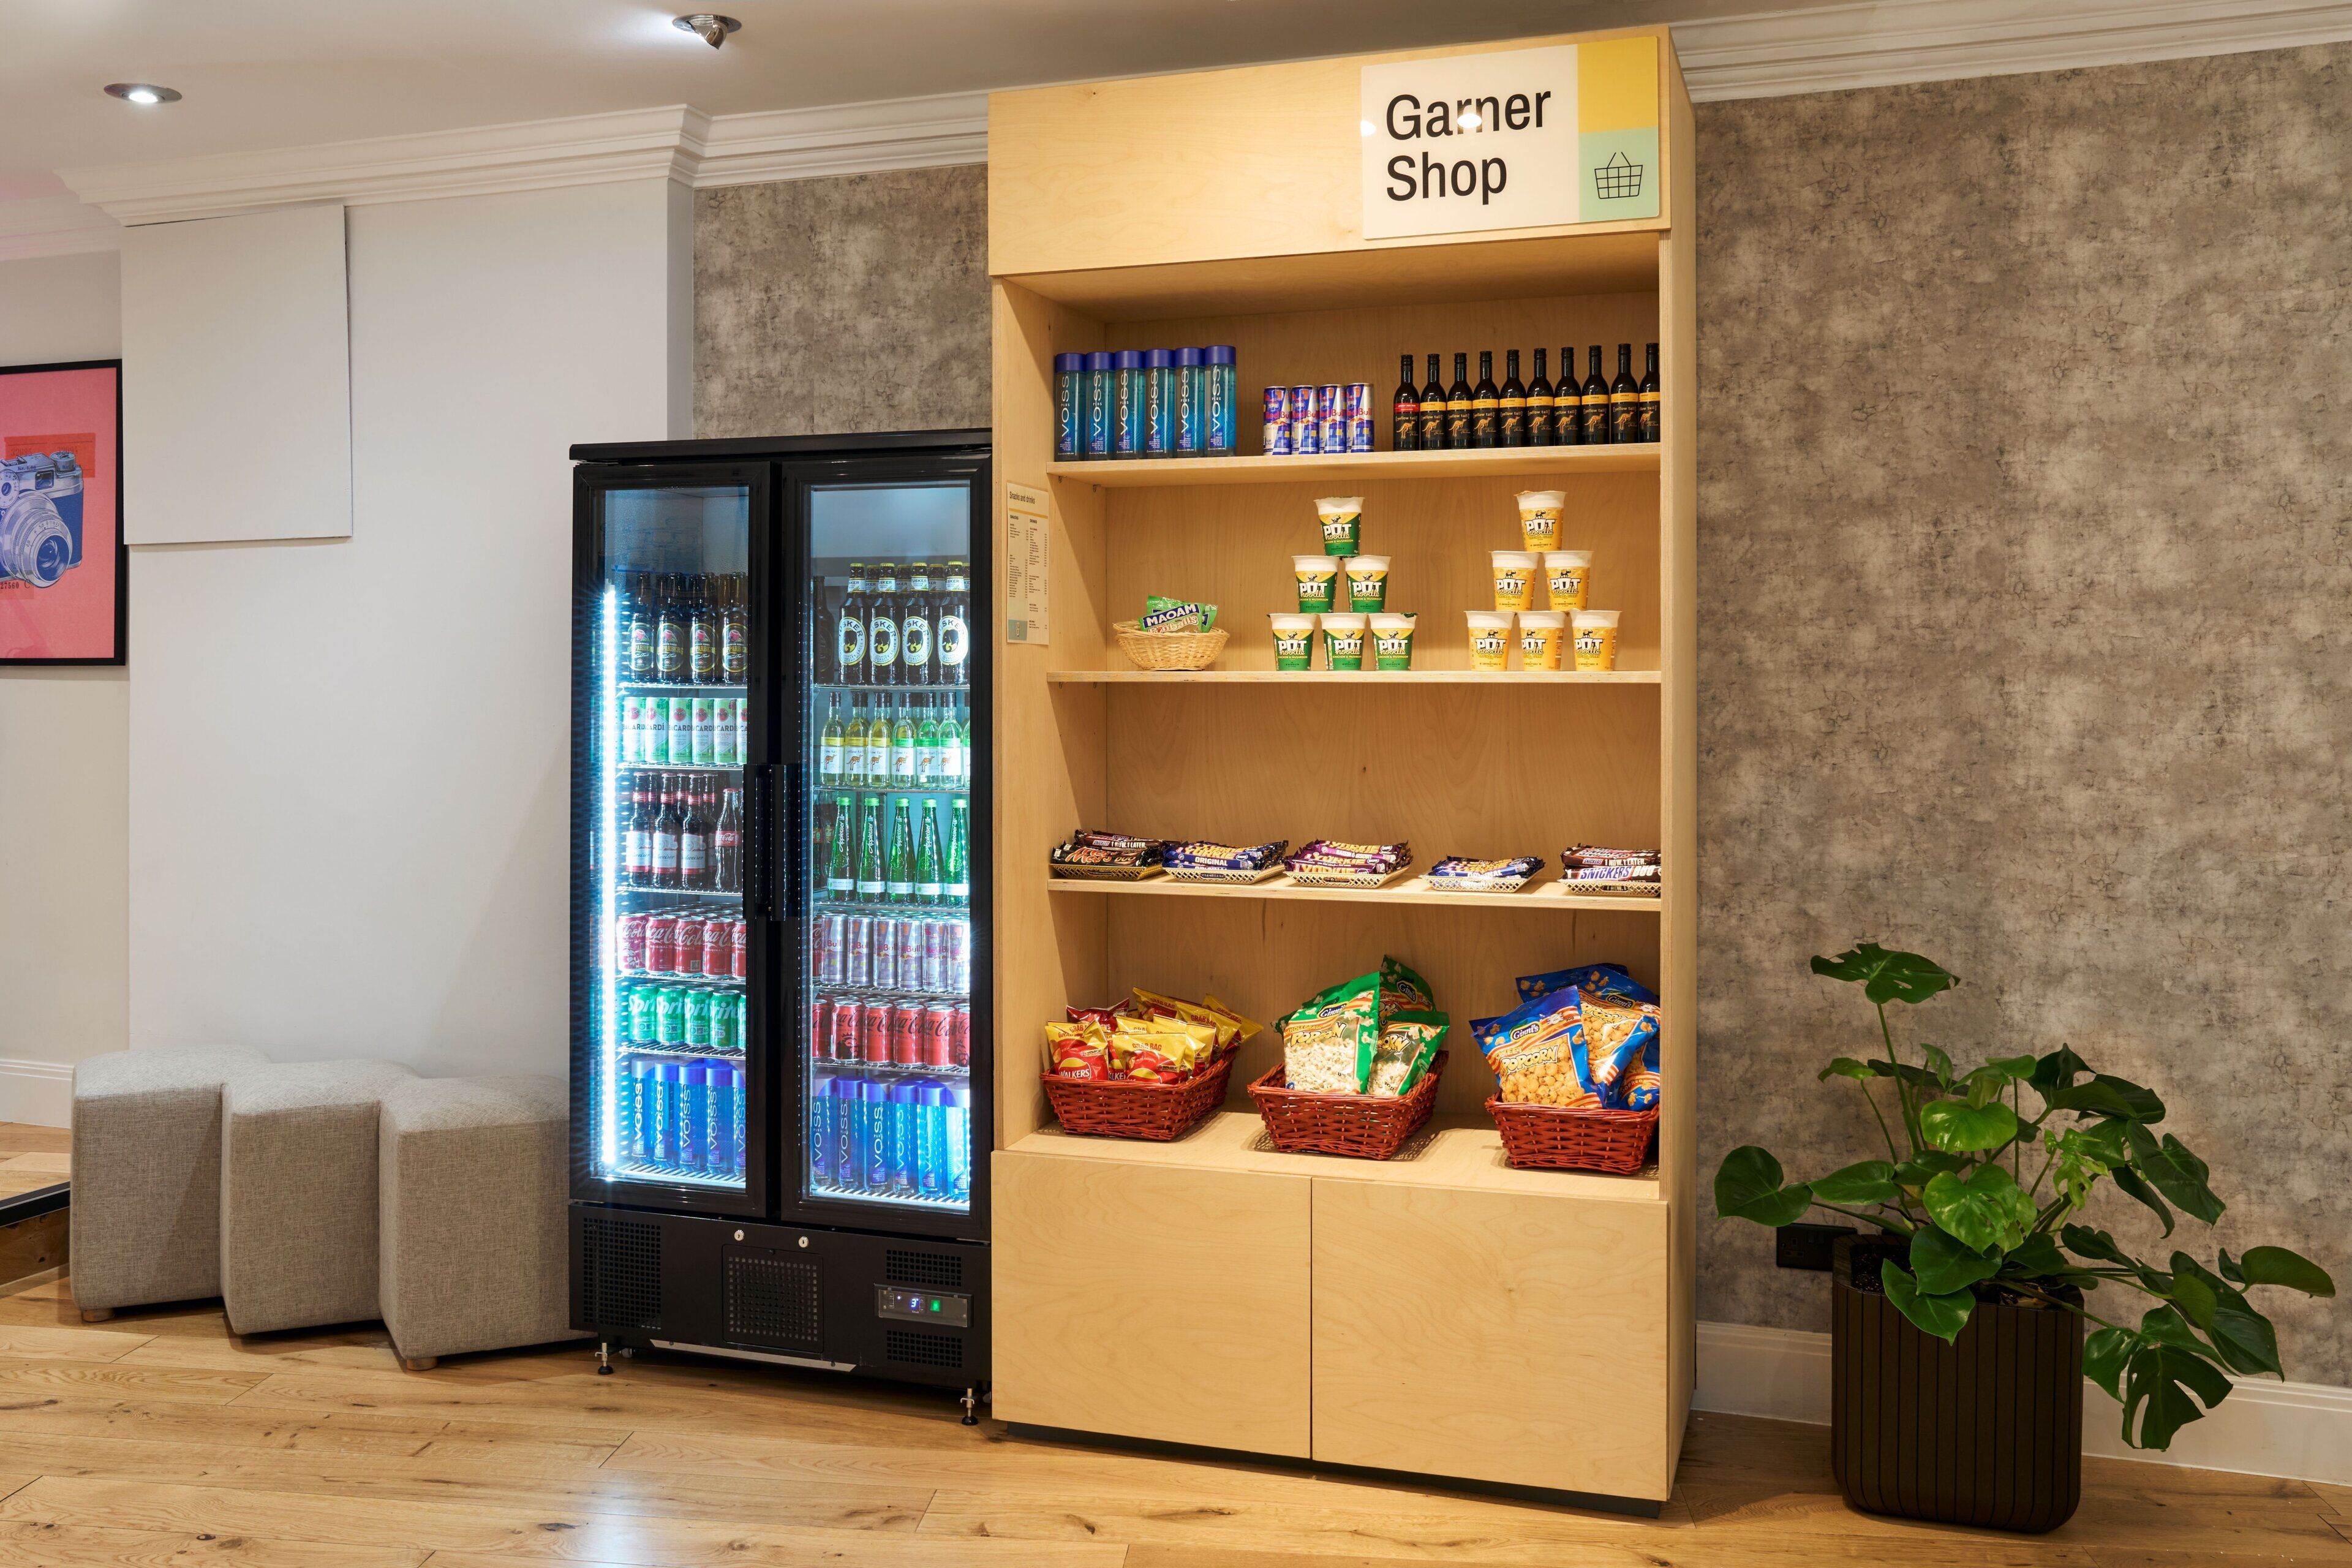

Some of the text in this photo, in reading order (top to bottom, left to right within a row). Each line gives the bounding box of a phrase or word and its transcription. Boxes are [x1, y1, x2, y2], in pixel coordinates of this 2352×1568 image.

[1385, 91, 1551, 140] Garner
[1386, 151, 1507, 206] Shop
[1181, 371, 1189, 433] VOSS
[1212, 369, 1221, 431] VOSS
[1009, 491, 1020, 500] Snacks
[1323, 523, 1352, 537] POT
[1525, 519, 1555, 532] POT
[1527, 527, 1554, 536] noodle
[1325, 530, 1350, 540] noodle
[1299, 581, 1328, 594] POT
[1352, 581, 1382, 593] POT
[1496, 578, 1526, 590] POT
[1550, 578, 1581, 590] POT
[1300, 589, 1325, 598] noodle
[1354, 589, 1379, 598] noodle
[1497, 586, 1523, 595] noodle
[1551, 586, 1579, 595] noodle
[1147, 604, 1196, 627] MAOAM
[1278, 639, 1307, 652] POT
[1334, 639, 1362, 650] POT
[1378, 639, 1408, 651] POT
[1476, 638, 1507, 650] POT
[1575, 638, 1604, 650] POT
[1279, 647, 1305, 656] noodle
[1335, 647, 1360, 655] noodle
[1379, 647, 1406, 655] noodle
[1477, 646, 1504, 655] noodle
[1575, 646, 1601, 655] noodle
[1330, 842, 1381, 854] YORKIE
[1195, 857, 1228, 866] ORIGINAL
[1581, 865, 1656, 879] SNICKERS DUO
[907, 944, 921, 952] Bull
[628, 995, 654, 1016] Spri
[657, 995, 684, 1016] Spri
[1191, 1014, 1216, 1027] GRAB BAG
[1501, 1045, 1559, 1073] POPCORN
[813, 1101, 822, 1161] VOSS
[874, 1106, 883, 1168] VOSS
